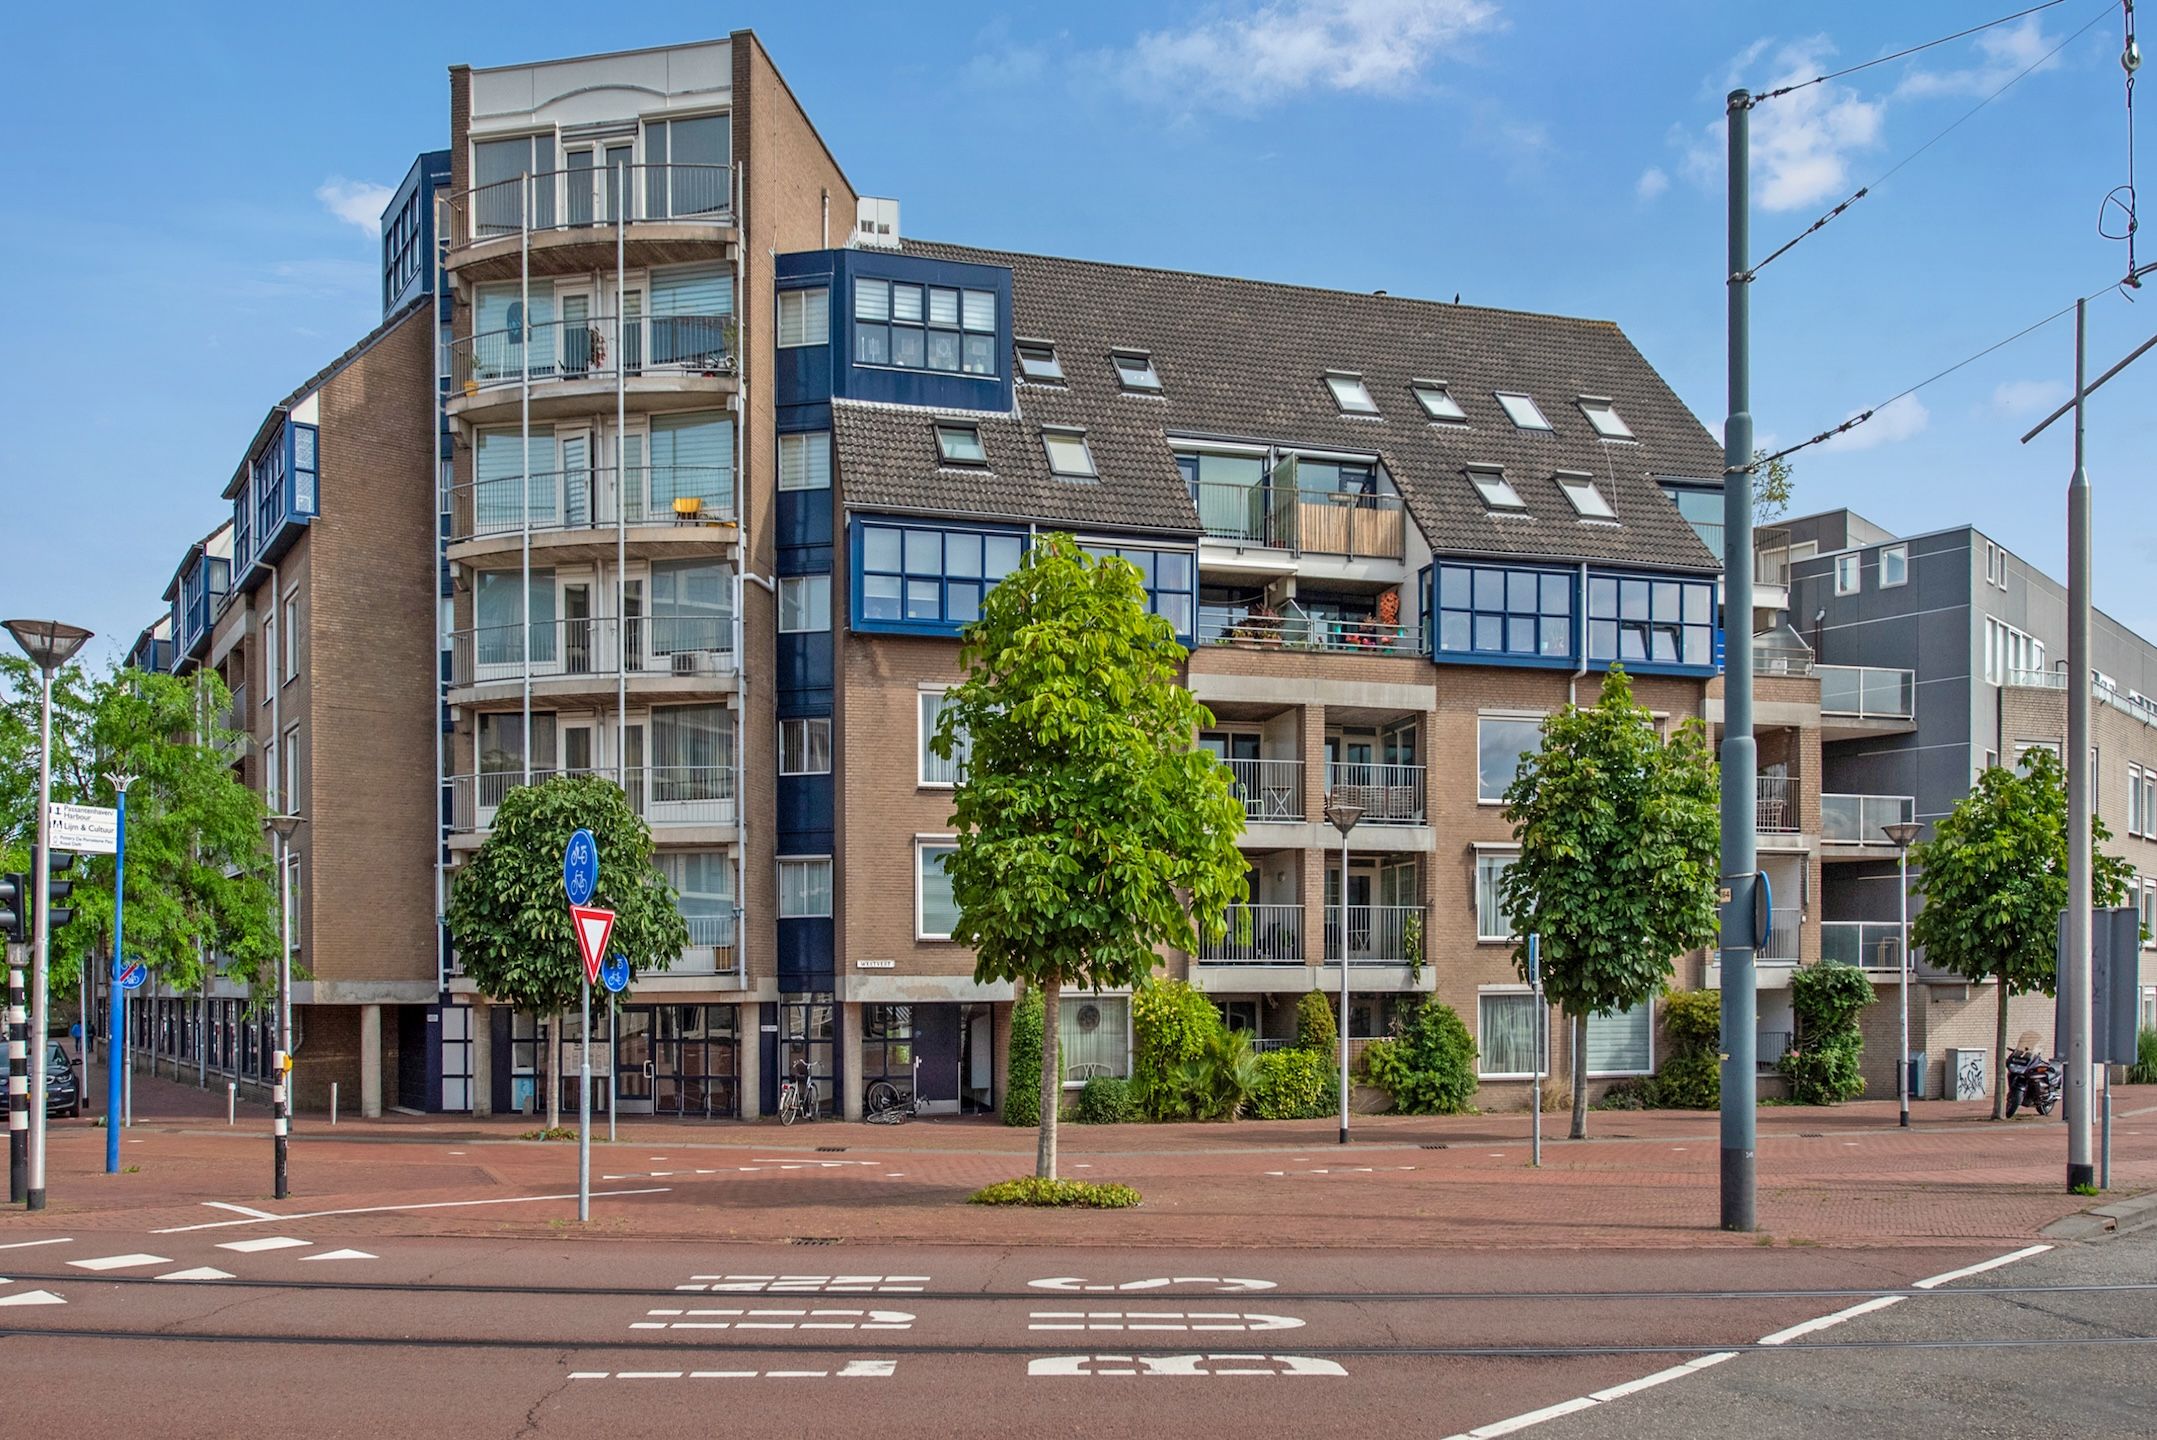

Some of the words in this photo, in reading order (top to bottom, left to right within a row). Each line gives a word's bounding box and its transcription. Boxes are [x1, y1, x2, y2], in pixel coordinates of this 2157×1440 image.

[63, 812, 92, 821] Harbour
[88, 824, 115, 834] Cultuur
[1028, 1277, 1347, 1376] BUS
